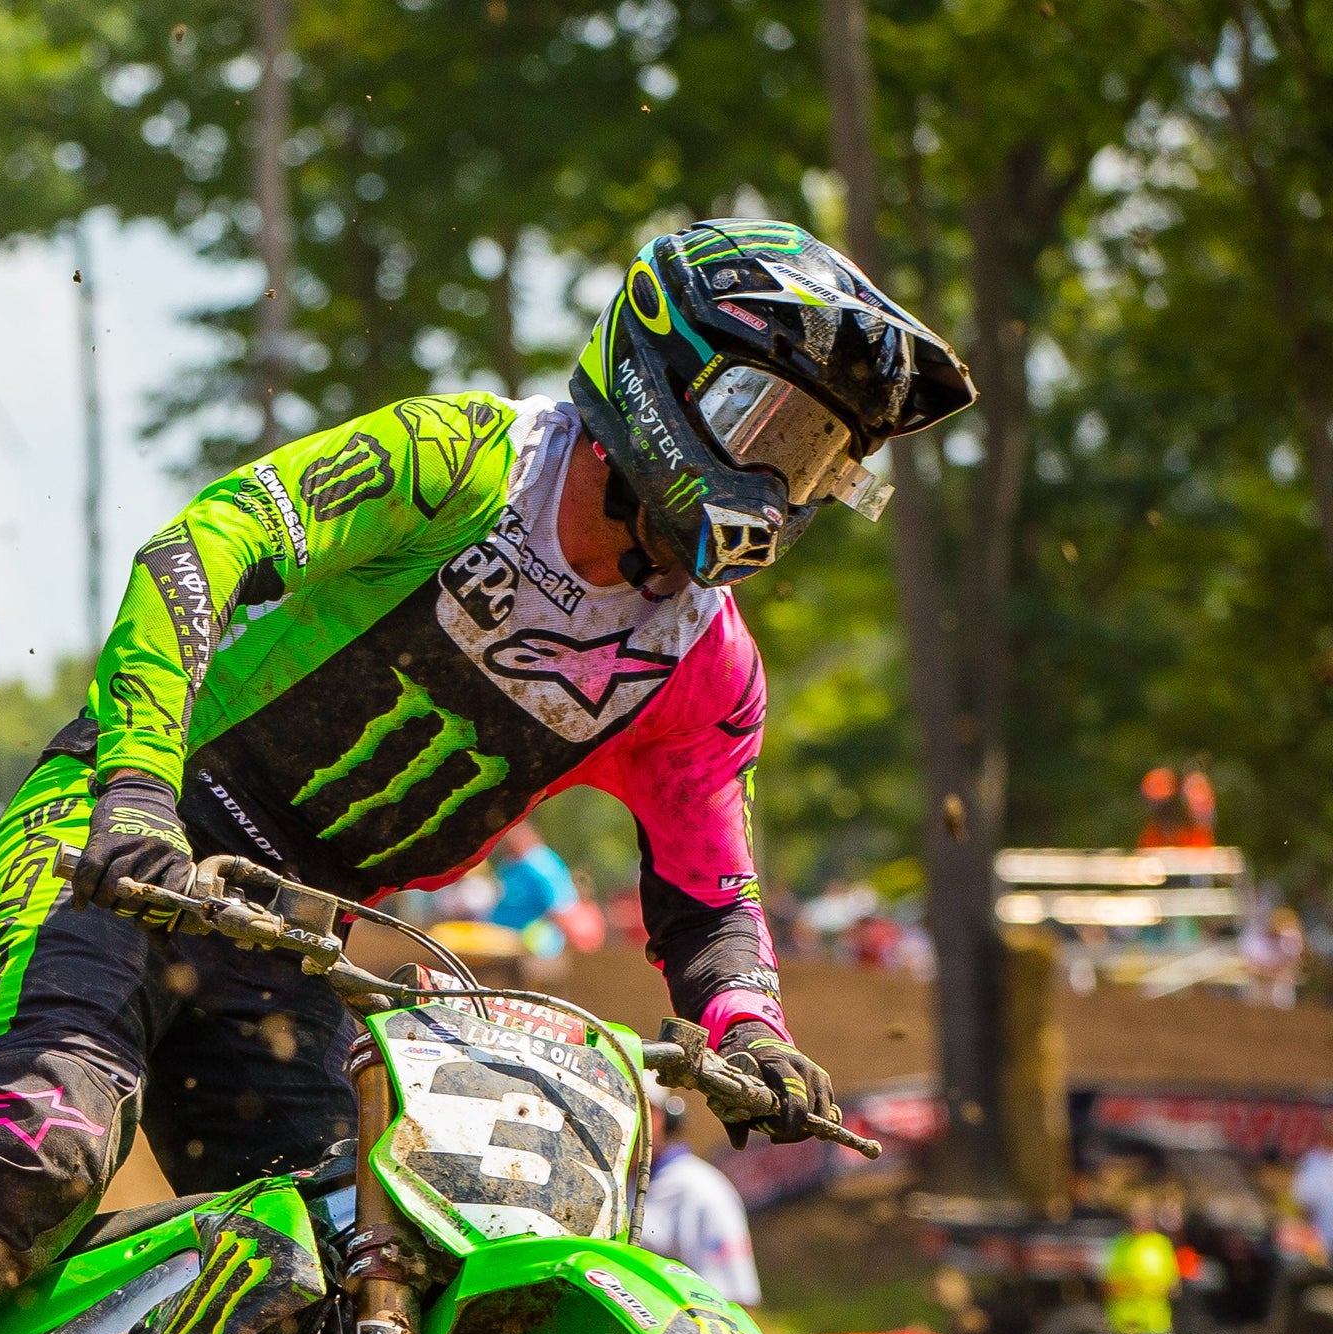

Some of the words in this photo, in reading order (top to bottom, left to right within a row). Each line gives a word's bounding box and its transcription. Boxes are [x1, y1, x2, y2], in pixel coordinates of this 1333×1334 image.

[615, 389, 658, 461] ENERGY
[495, 505, 585, 615] Kaasaki
[160, 575, 196, 678] ENERGY
[171, 551, 213, 688] MONSTE
[108, 822, 193, 856] ASTARS
[466, 1025, 546, 1056] LUCAS
[549, 1046, 583, 1074] OIL
[410, 1060, 625, 1238] 3
